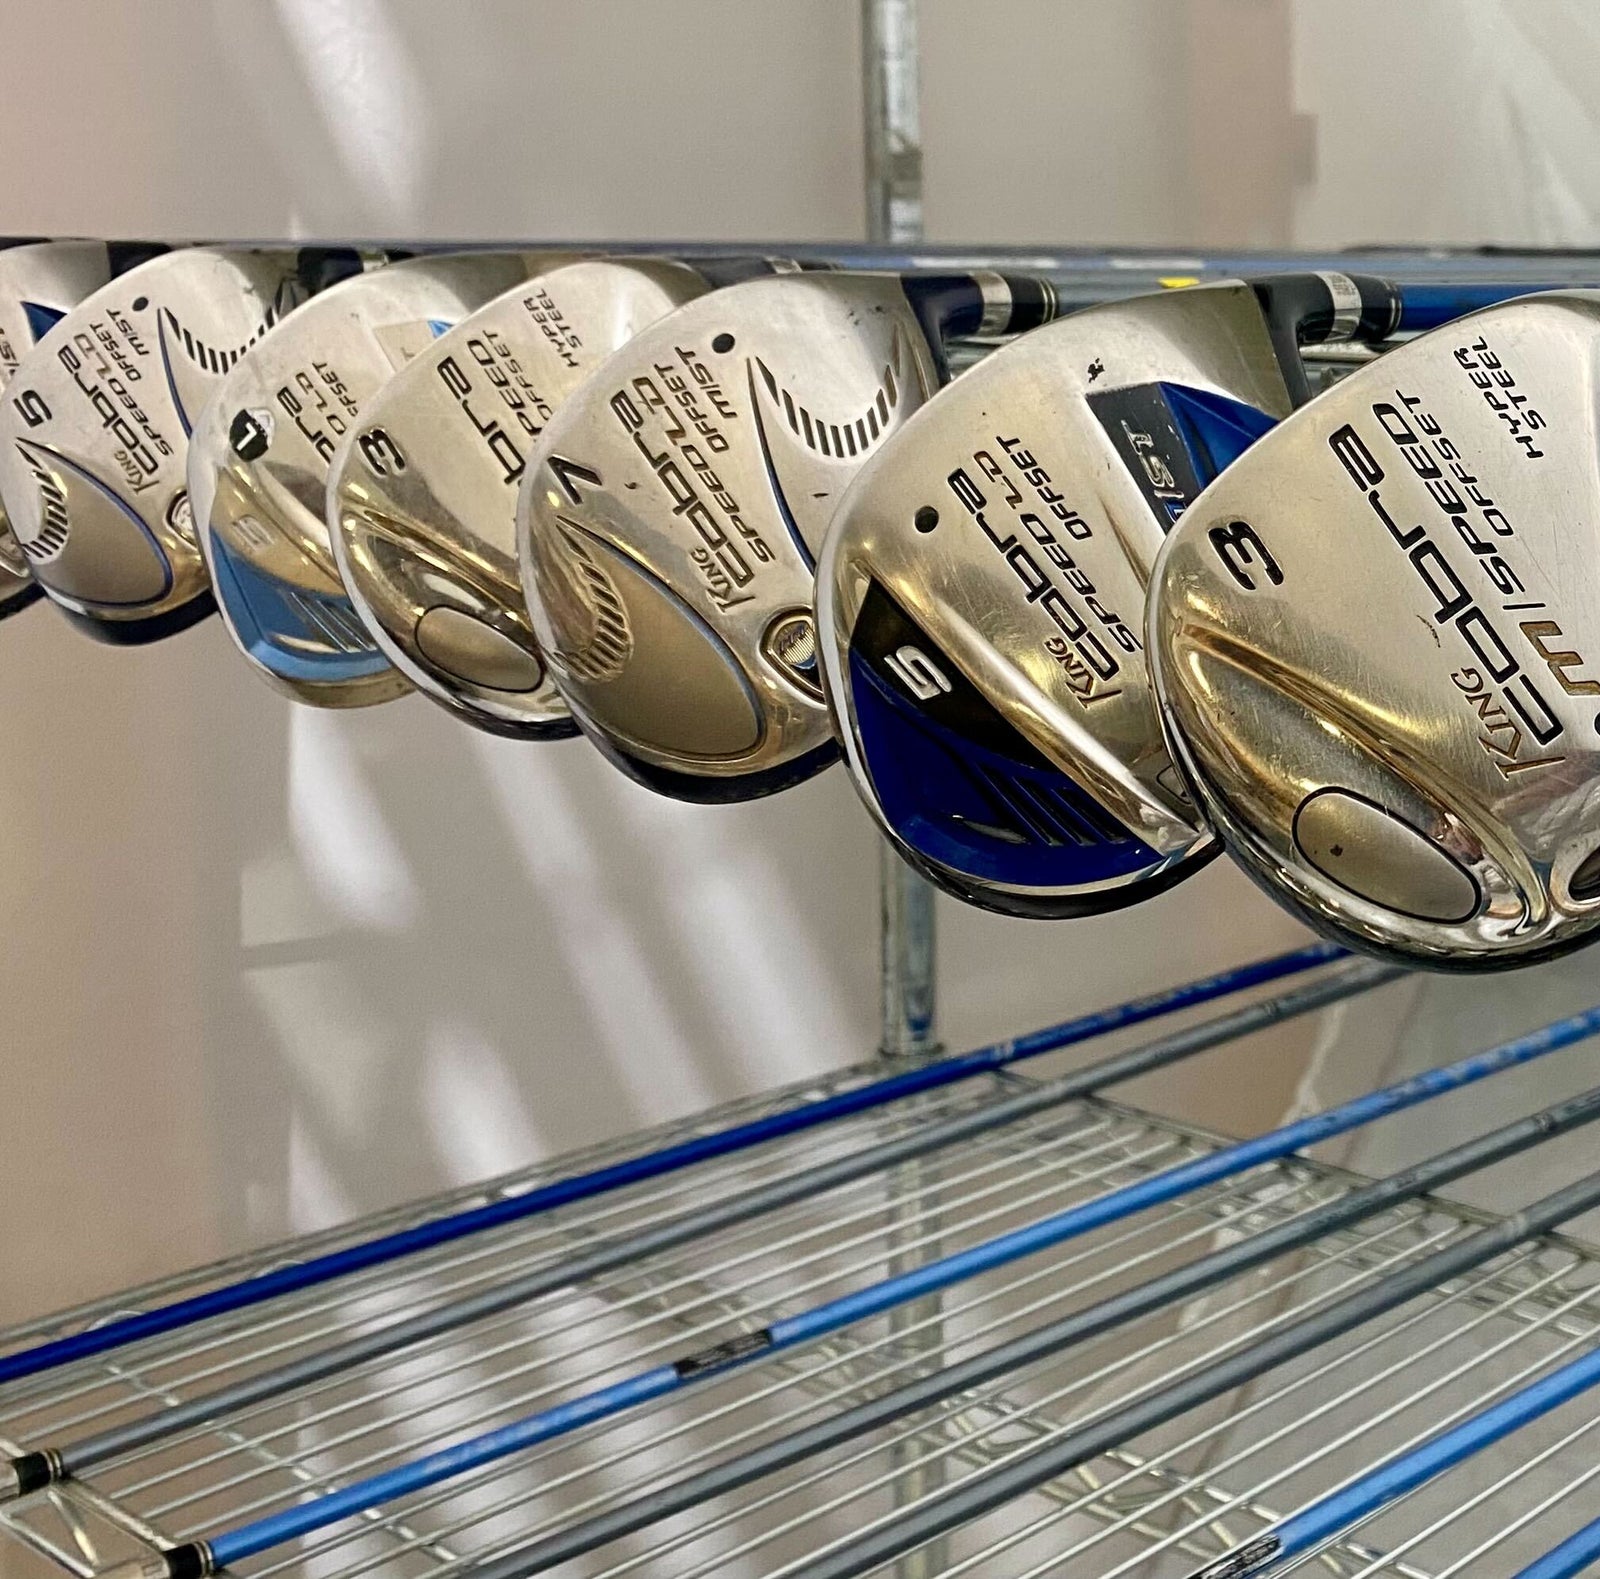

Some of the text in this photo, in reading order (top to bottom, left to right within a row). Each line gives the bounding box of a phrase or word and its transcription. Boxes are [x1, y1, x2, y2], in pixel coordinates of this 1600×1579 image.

[90, 323, 142, 383] OFFSET
[523, 297, 580, 368] HYPER
[536, 287, 583, 349] STEEL
[13, 389, 52, 428] 5
[57, 344, 160, 477] cobra
[107, 378, 175, 457] SPEED
[437, 356, 526, 485] bra
[467, 339, 542, 437] PEED
[483, 329, 553, 421] OFFSET
[653, 363, 730, 453] OFFSET
[1453, 348, 1545, 459] HYPER
[1472, 336, 1547, 430] STEEL
[113, 450, 160, 495] KING
[357, 428, 405, 476] 3
[548, 456, 602, 505] 7
[610, 389, 756, 589] cobra
[996, 435, 1093, 540] OFFSET
[1395, 389, 1514, 537] OFFSET
[680, 444, 776, 563] SPEED
[690, 547, 756, 613] KING
[947, 467, 1120, 682] cobra
[1019, 513, 1143, 653] SPEED
[1208, 521, 1284, 590] 3
[1328, 423, 1564, 746] cobra
[884, 645, 952, 700] 5
[1043, 636, 1123, 709] KING
[1450, 666, 1567, 779] KING
